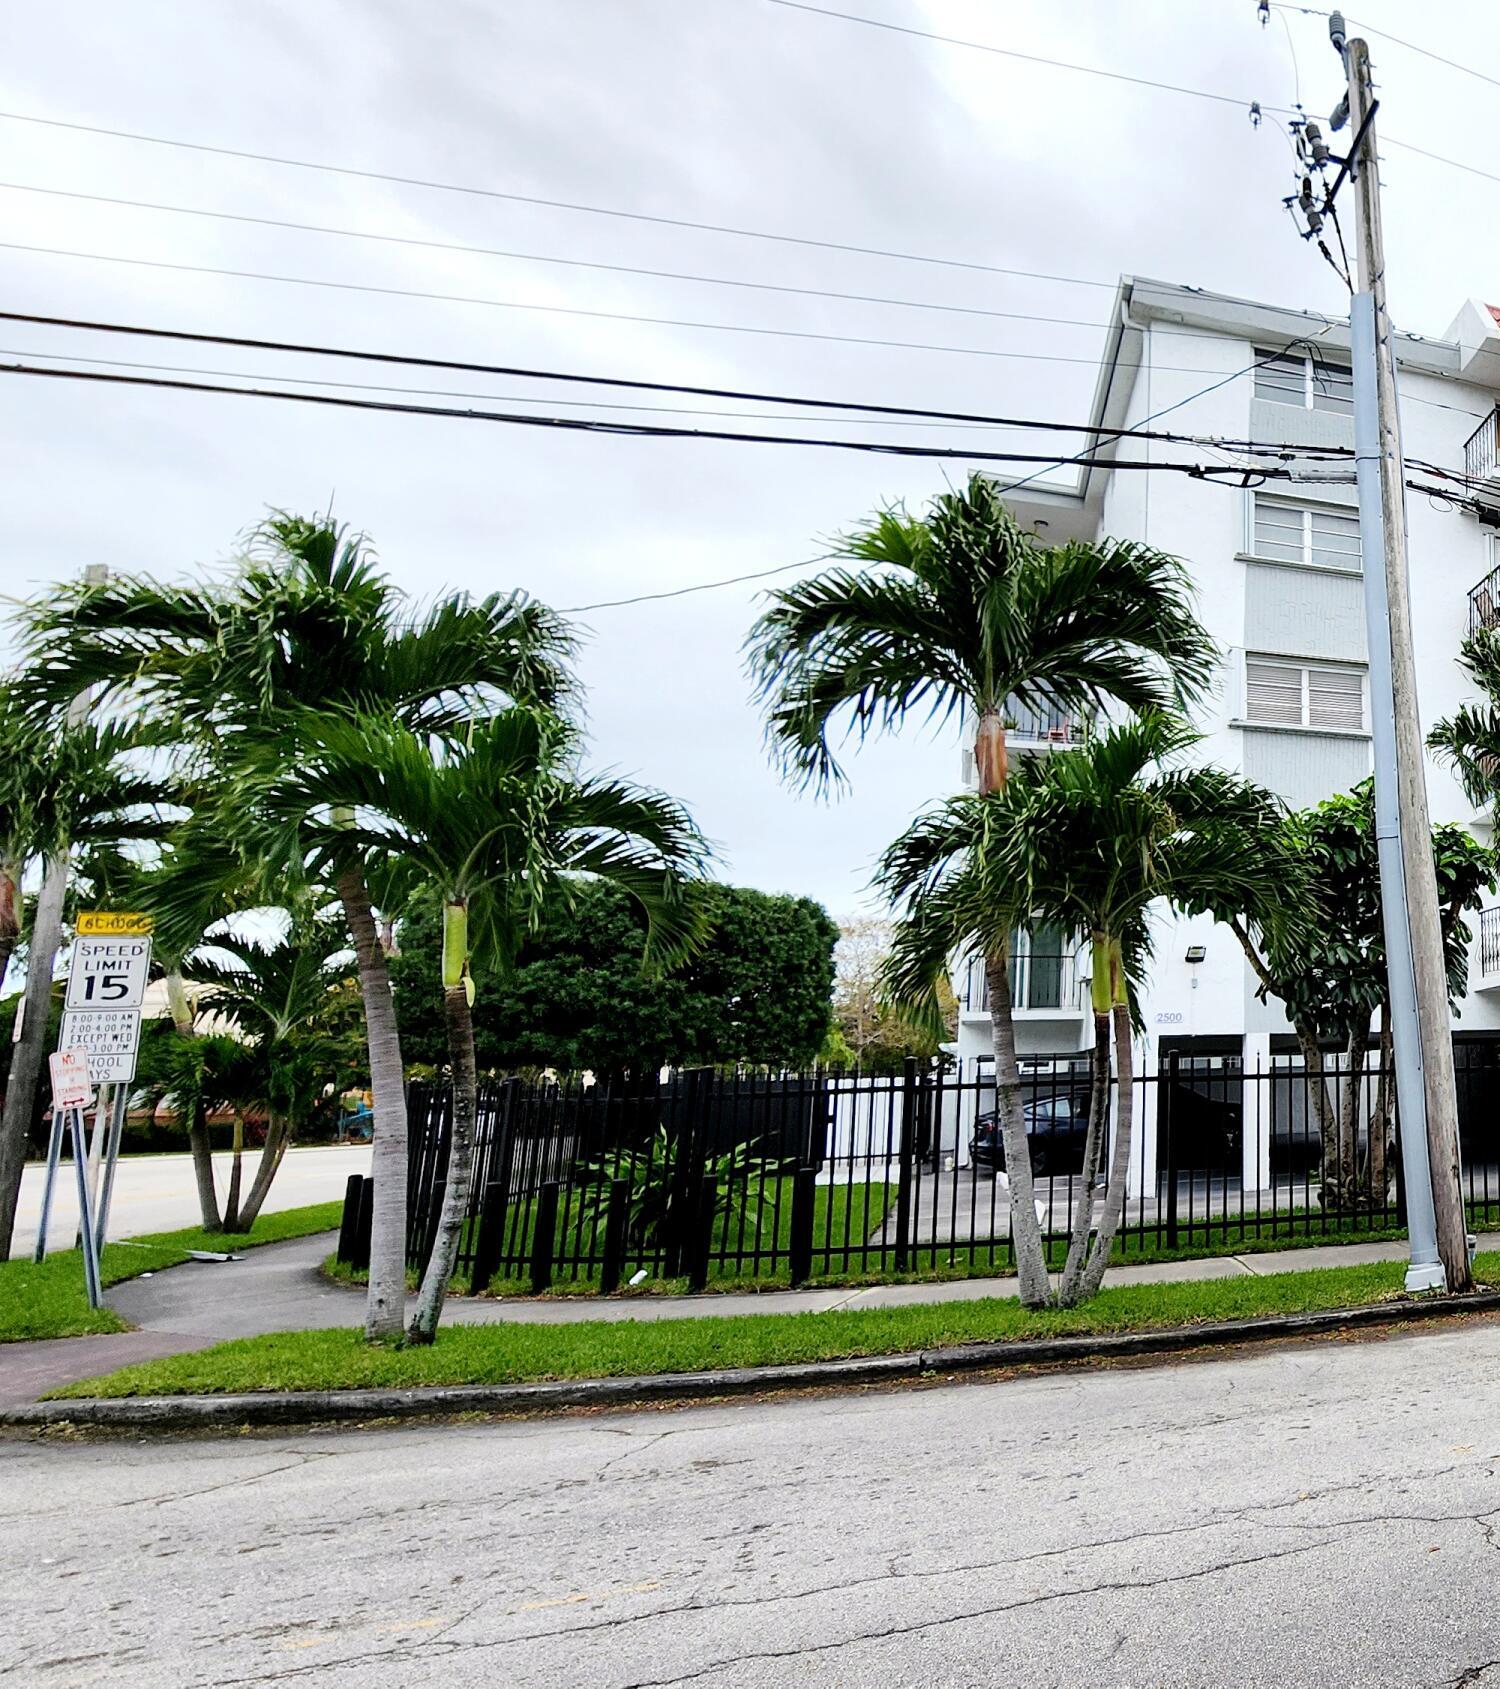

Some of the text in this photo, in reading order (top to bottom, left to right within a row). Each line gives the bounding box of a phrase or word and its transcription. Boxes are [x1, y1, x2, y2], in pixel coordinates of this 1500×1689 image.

[80, 945, 144, 956] SPEED
[84, 960, 133, 971] LIMIT
[84, 975, 129, 1001] 15
[1157, 1012, 1183, 1022] 2500
[120, 1023, 132, 1031] PM
[70, 1033, 132, 1044] EXCEPT WED
[116, 1044, 129, 1052] PM
[62, 1054, 76, 1065] NO
[87, 1057, 123, 1068] HOOL
[89, 1069, 111, 1080] AYS
